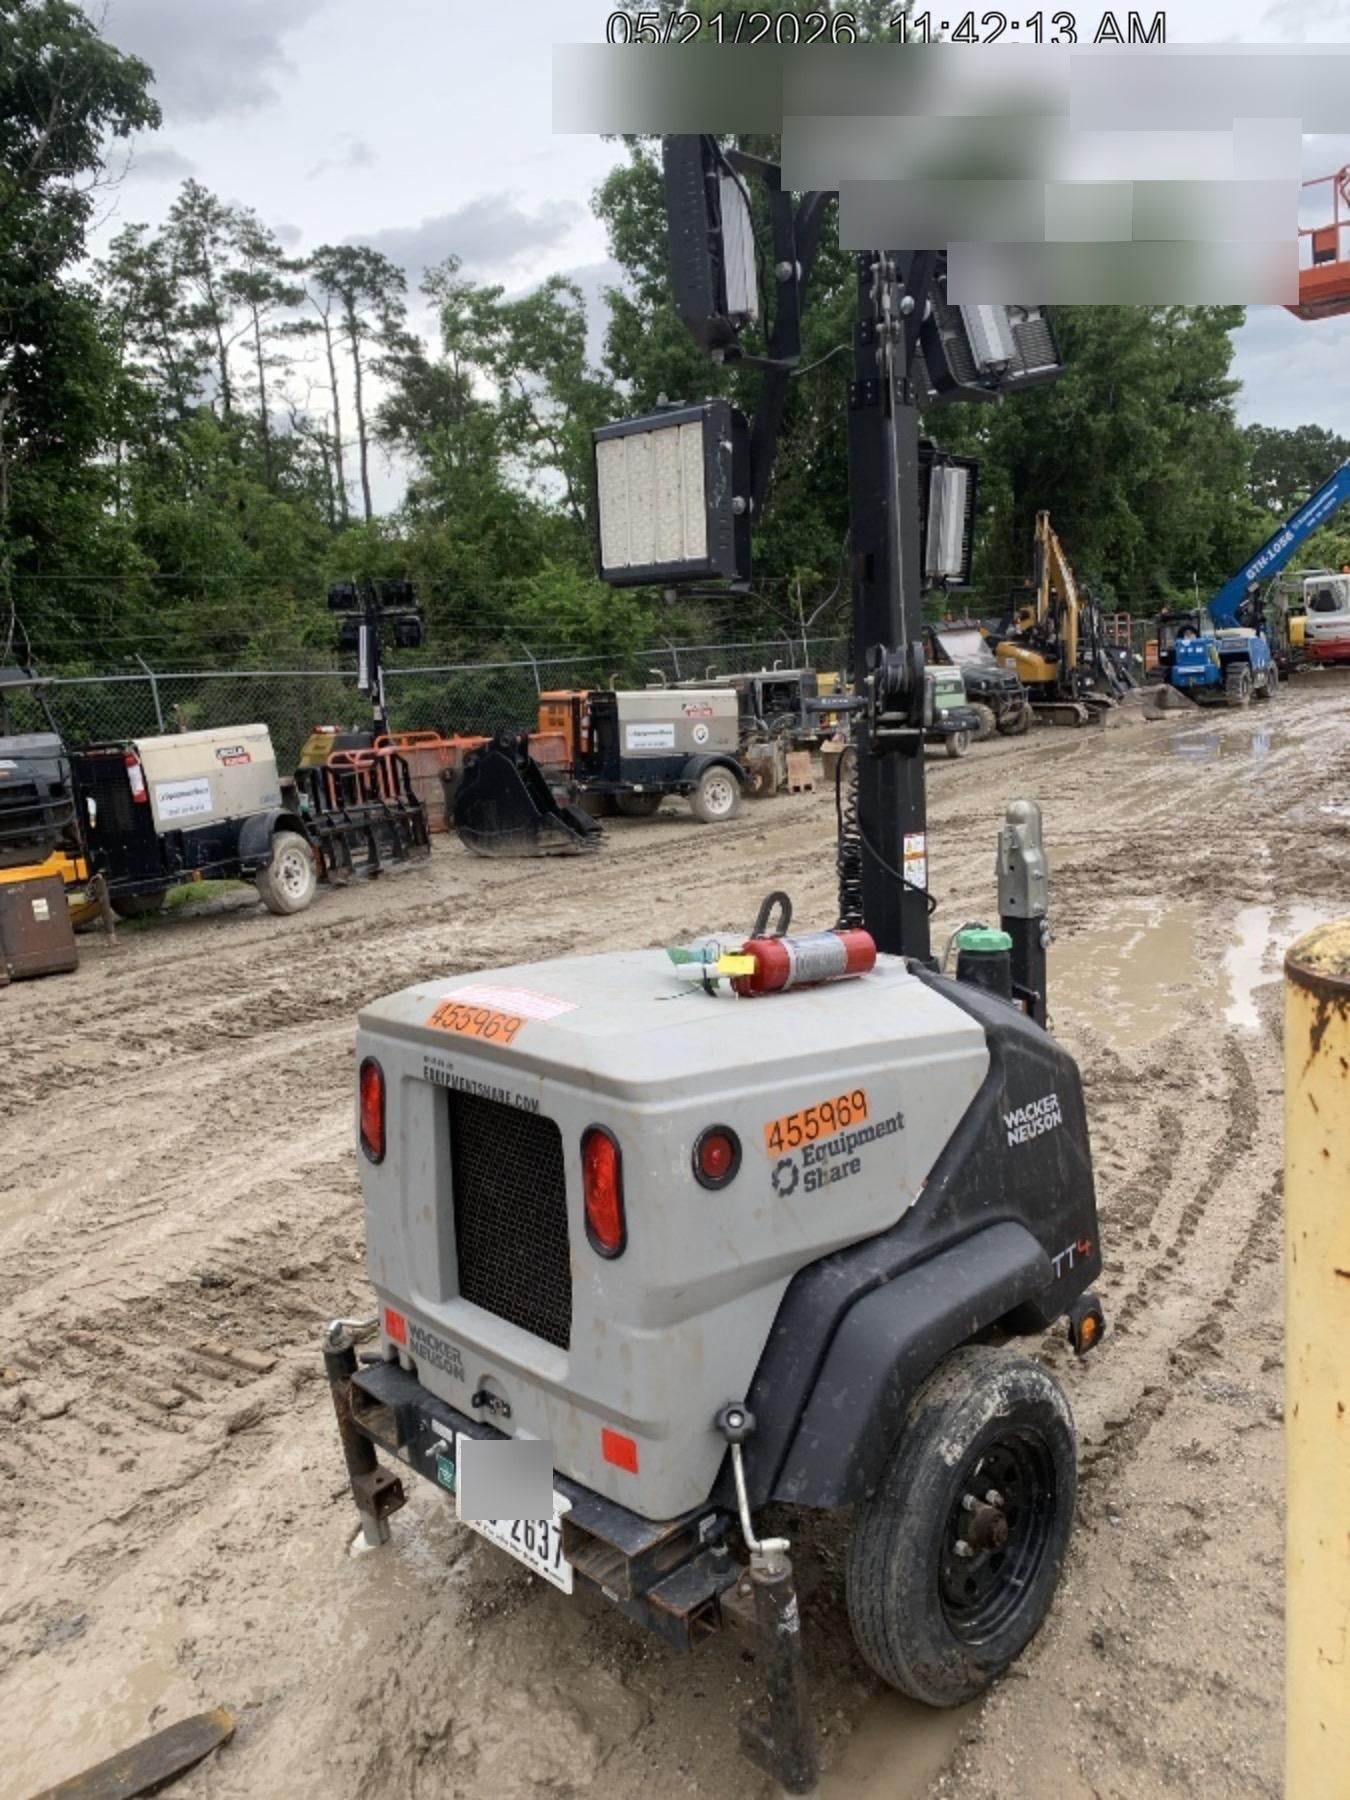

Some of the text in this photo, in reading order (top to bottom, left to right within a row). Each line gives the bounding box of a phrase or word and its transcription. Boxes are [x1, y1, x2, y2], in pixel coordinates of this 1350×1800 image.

[431, 1004, 521, 1043] 455969
[768, 1089, 867, 1152] 455969
[1004, 1093, 1060, 1128] WACKER
[1007, 1109, 1063, 1147] NEUSON
[802, 1112, 905, 1168] Equipment
[804, 1157, 861, 1193] Share
[409, 1325, 463, 1365] WACKER
[410, 1340, 465, 1384] NEUSON
